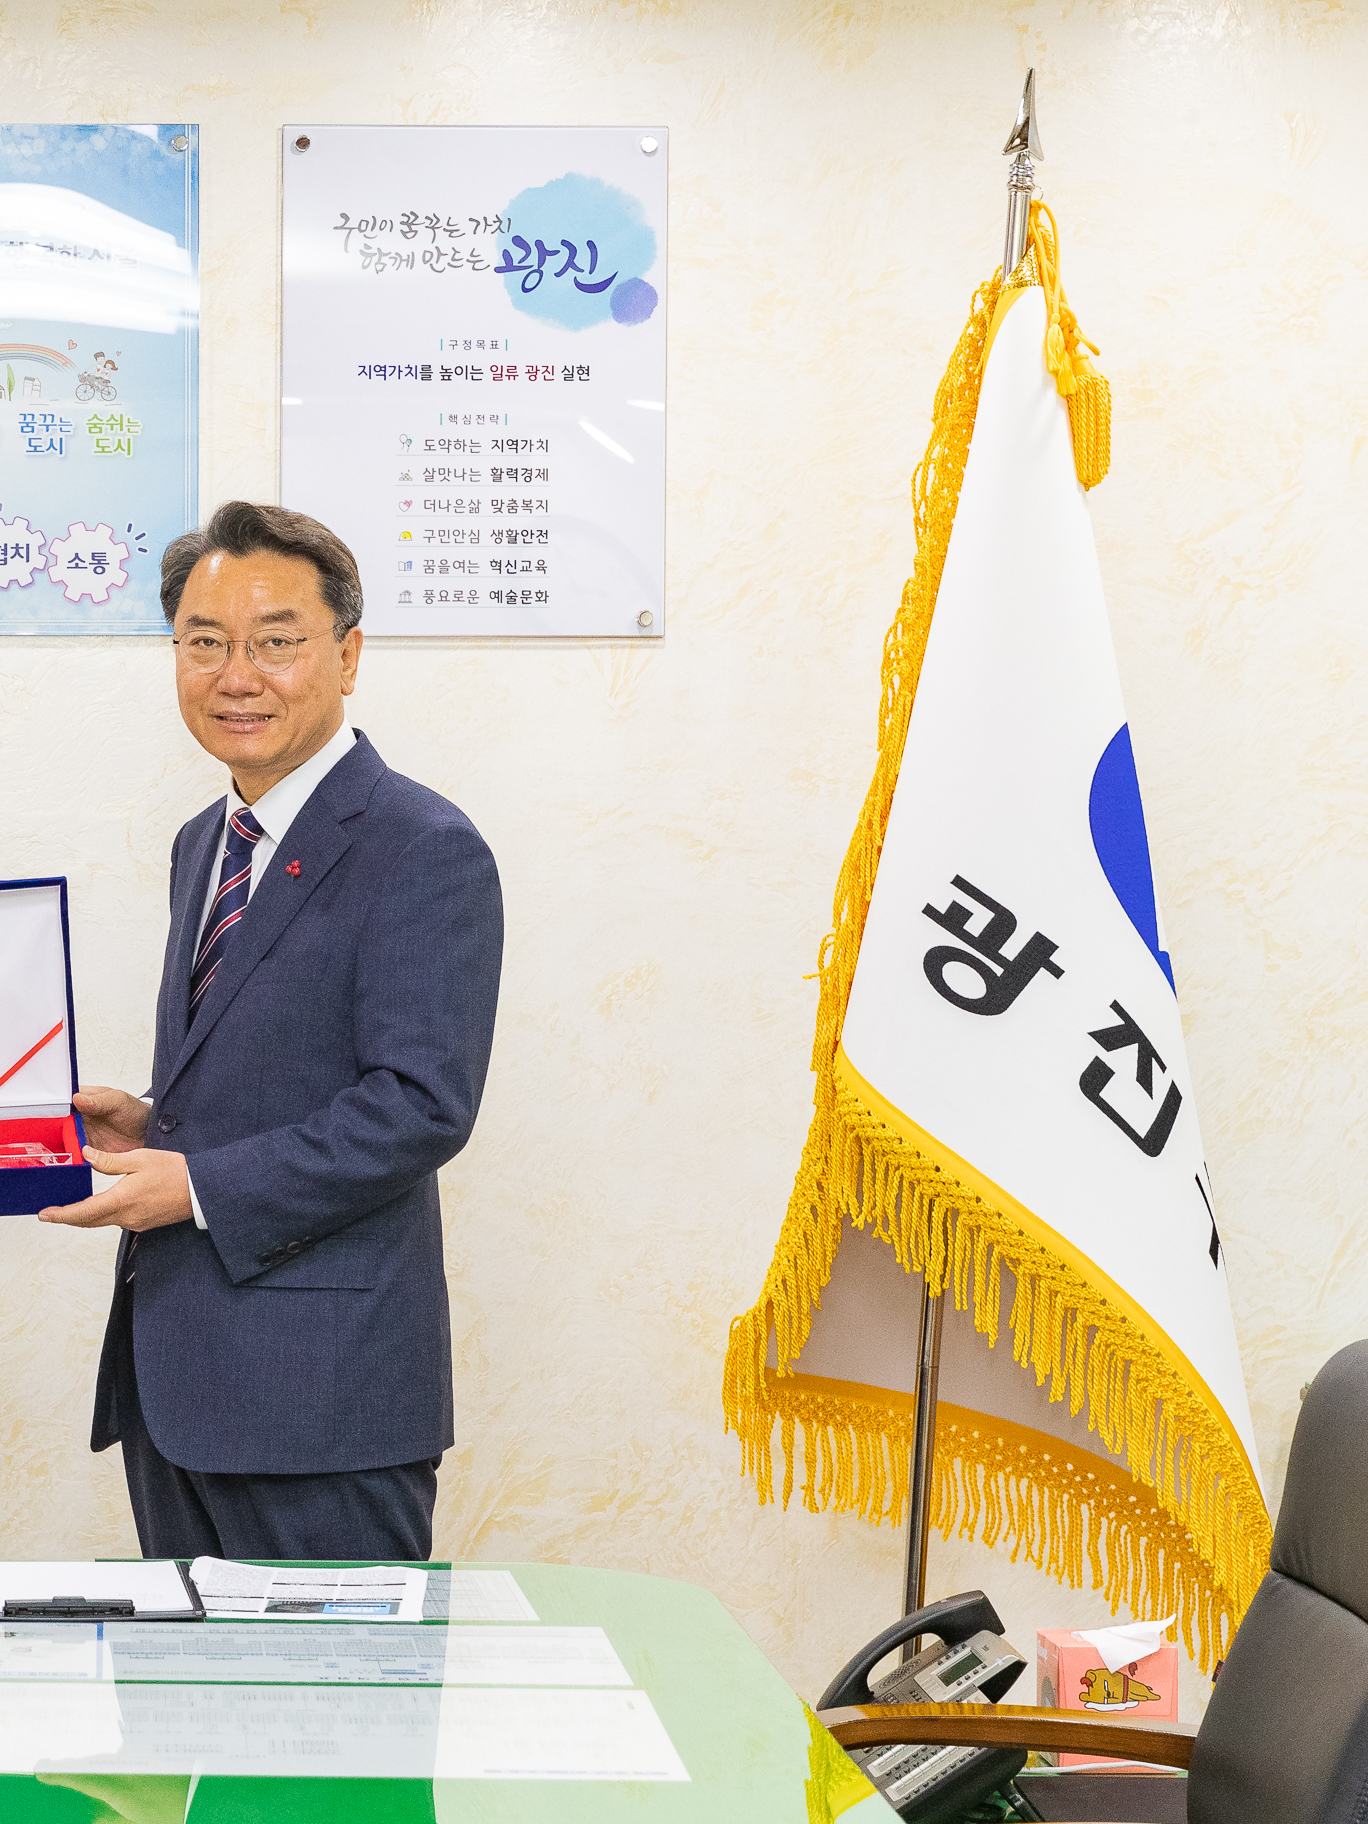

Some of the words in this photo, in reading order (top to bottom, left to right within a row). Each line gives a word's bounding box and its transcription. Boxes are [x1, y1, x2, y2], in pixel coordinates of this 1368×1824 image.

[333, 212, 394, 253] 구민이
[399, 211, 465, 243] 꿈꾸는
[469, 216, 512, 235] 가치
[359, 243, 416, 274] 함께
[422, 246, 491, 273] 만드는
[494, 235, 619, 294] 광진
[448, 339, 500, 351] 구정목표
[357, 364, 433, 382] 지역가치를
[439, 364, 484, 382] 높이는
[490, 364, 519, 382] 일류
[525, 364, 555, 382] 광진
[561, 364, 591, 382] 실현
[18, 413, 73, 434] 꿈꾸는
[85, 413, 141, 434] 숨쉬는
[448, 414, 500, 426] 핵심전략
[25, 437, 64, 456] 도시
[93, 437, 132, 456] 도시
[423, 438, 482, 454] 도약하는
[490, 438, 549, 454] 지역가치
[422, 467, 482, 483] 살맛나는
[490, 467, 549, 483] 활력경제
[423, 498, 482, 514] 더나은삶
[490, 498, 549, 514] 맞춤복지
[422, 529, 481, 544] 구민안심
[490, 529, 549, 544] 생활안전
[66, 551, 110, 575] 소통
[422, 559, 481, 575] 꿈을여는
[489, 559, 548, 575] 혁신교육
[422, 589, 481, 605] 풍요로운
[489, 589, 549, 605] 예술문화
